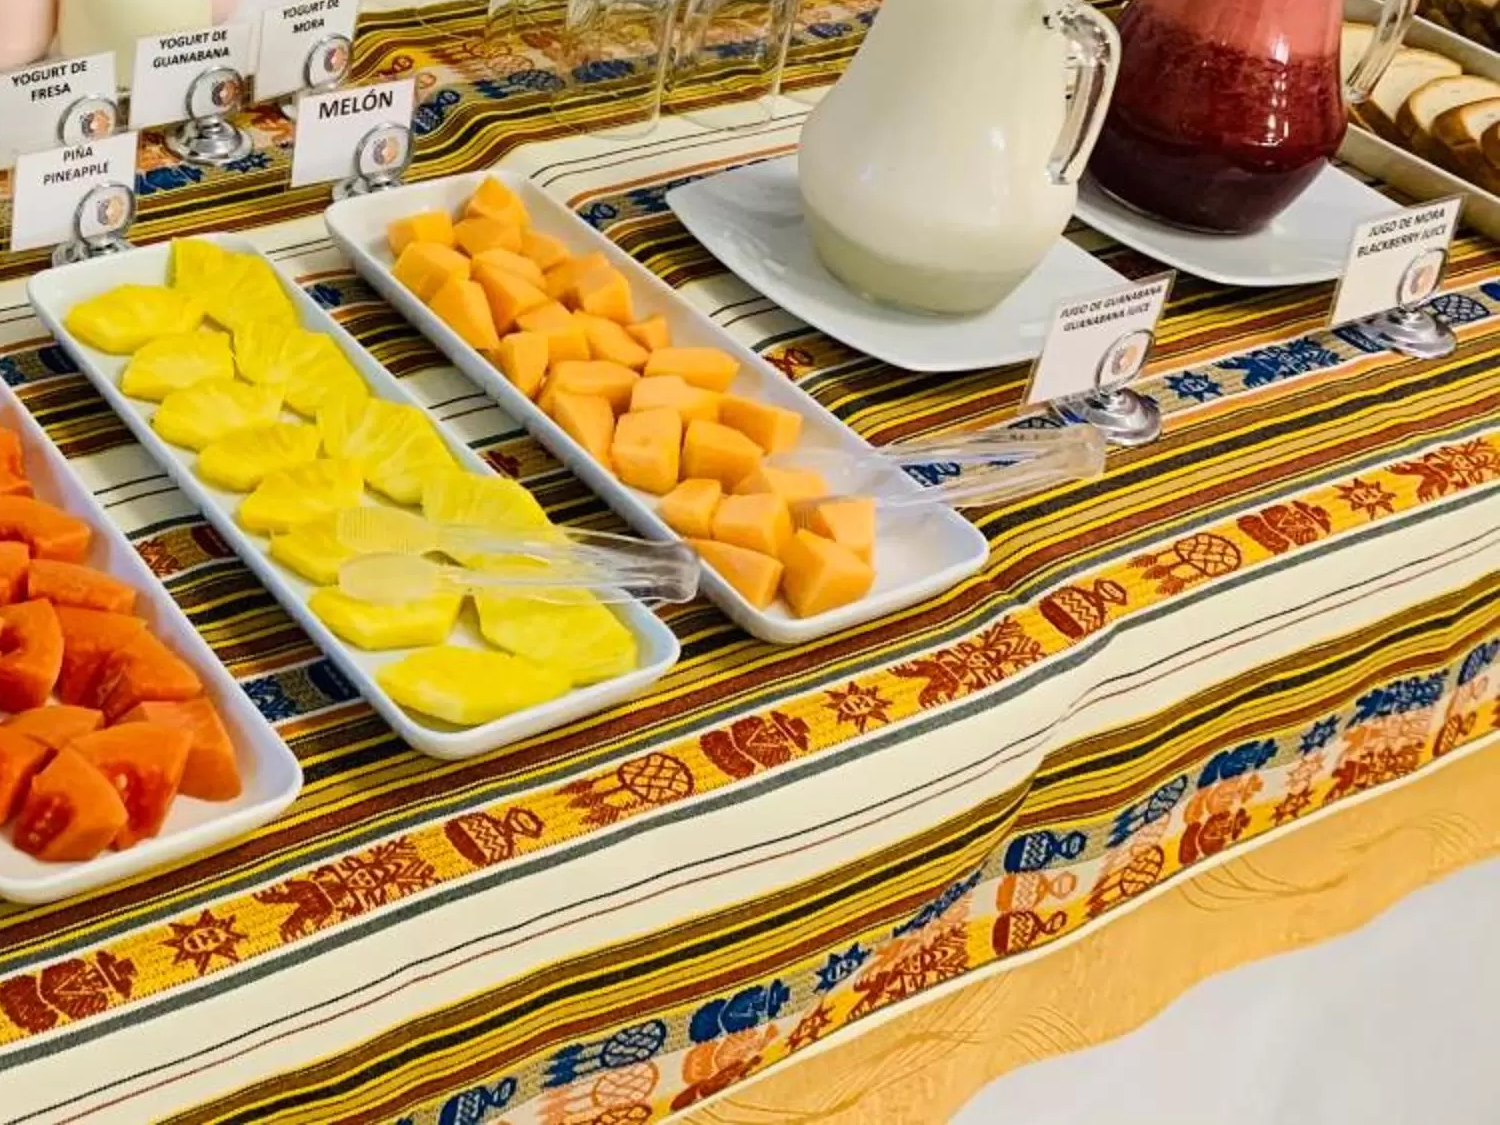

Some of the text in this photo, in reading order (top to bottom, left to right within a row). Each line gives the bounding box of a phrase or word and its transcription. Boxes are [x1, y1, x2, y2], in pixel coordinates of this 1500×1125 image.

[282, 0, 325, 20] YOGURT
[292, 18, 325, 34] MORA
[159, 29, 228, 50] YOGURT DE
[153, 46, 230, 69] GUANABANA
[11, 60, 88, 88] YOGURT DE
[31, 82, 71, 102] FRESA
[319, 88, 394, 120] MELÓN
[42, 160, 109, 186] PINEAPPLE
[1367, 207, 1446, 237] JUGO DE MORA
[1357, 232, 1420, 258] BLACKBERRY
[1103, 285, 1163, 309] GUANABANA
[1063, 309, 1125, 332] GUANABANA
